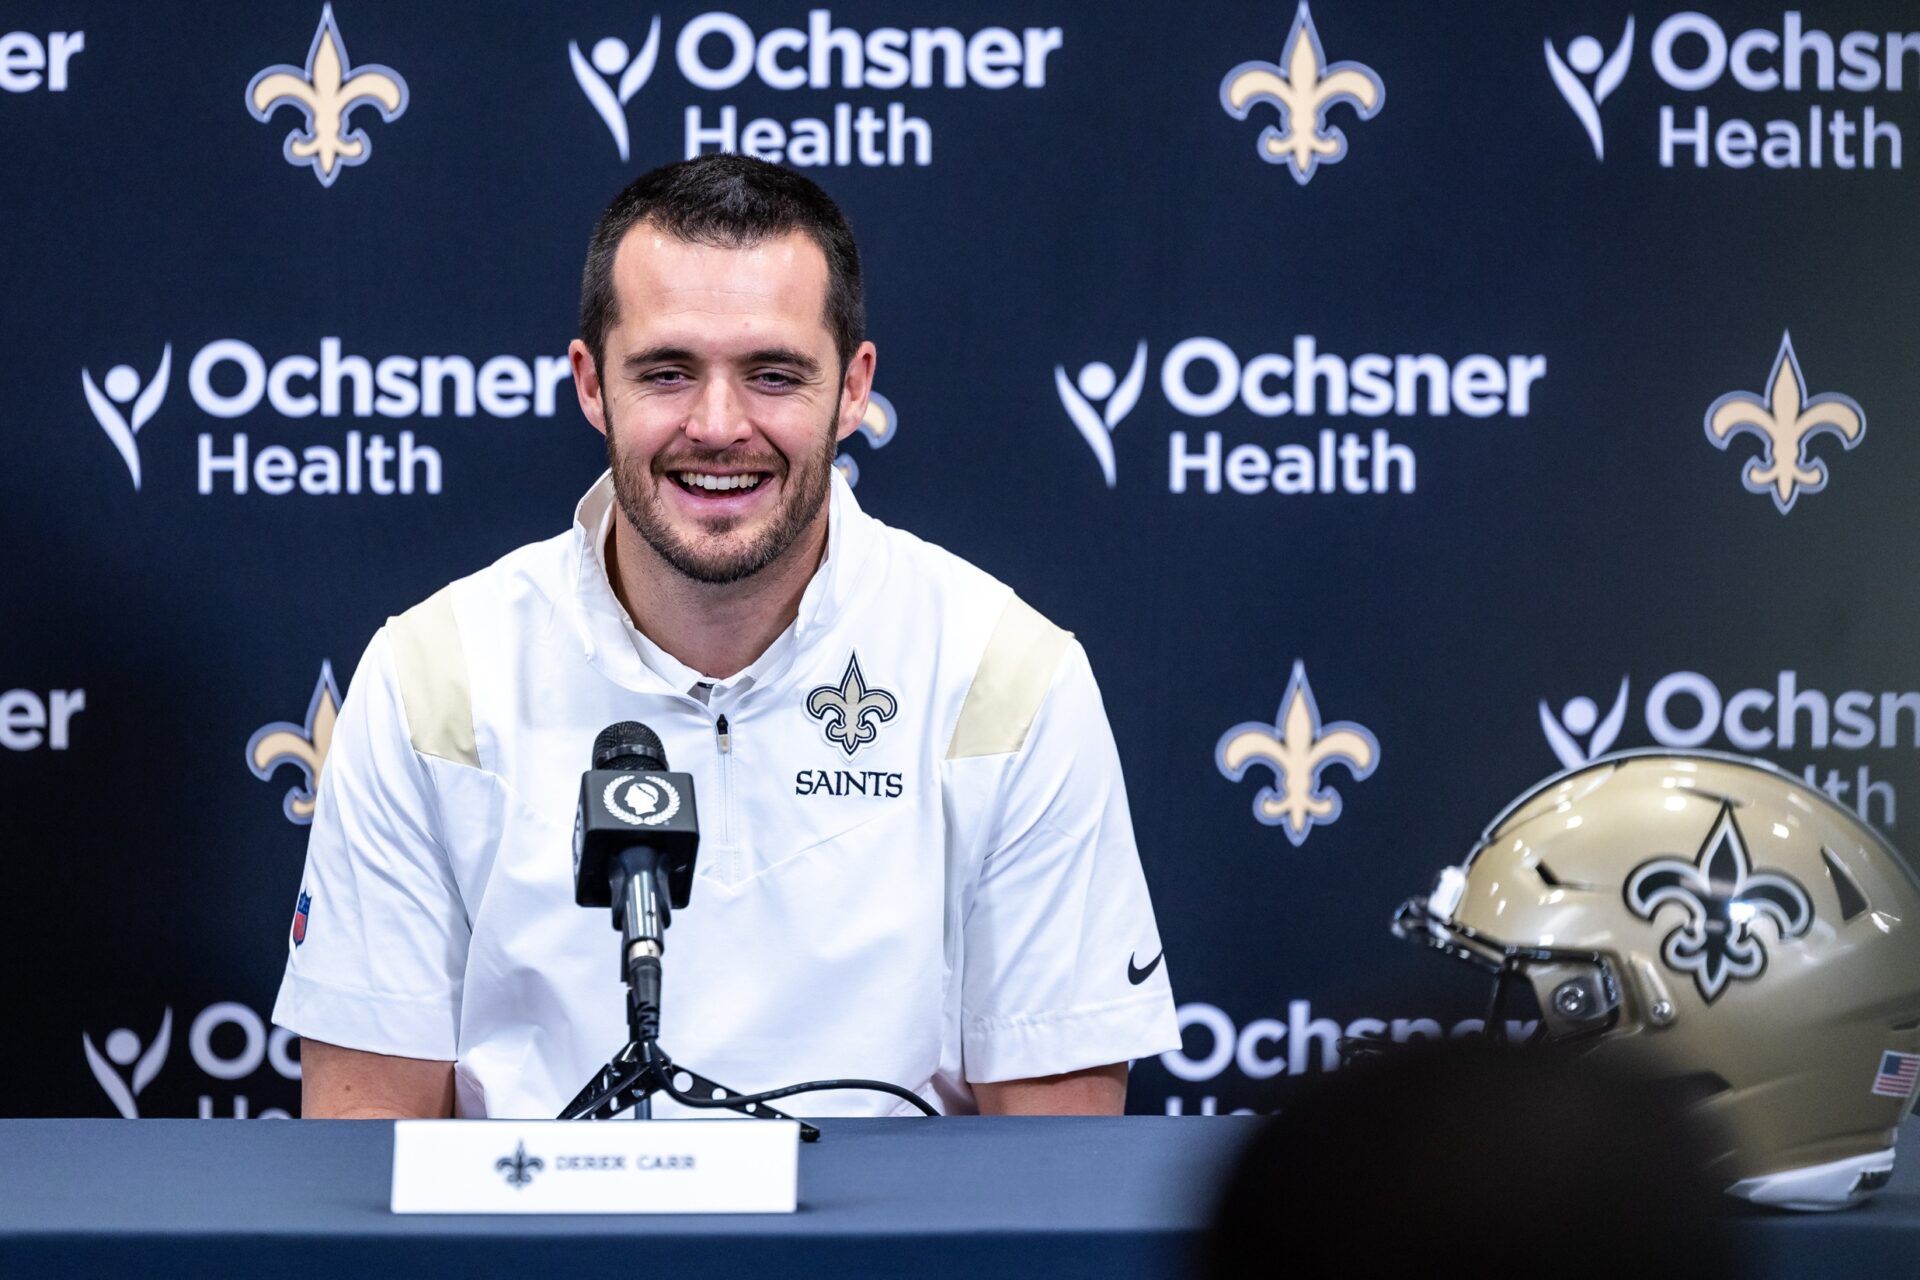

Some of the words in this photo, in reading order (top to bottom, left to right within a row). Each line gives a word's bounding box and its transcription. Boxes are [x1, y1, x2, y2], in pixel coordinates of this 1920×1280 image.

[676, 9, 1063, 90] Ochsner
[684, 102, 932, 166] Health
[1659, 105, 1902, 169] Health
[188, 336, 571, 417] Ochsner
[1161, 335, 1547, 417] Ochsner
[198, 430, 442, 495] Health
[1169, 429, 1416, 494] Health
[795, 769, 903, 798] SAINTS
[636, 1154, 696, 1171] CARR
